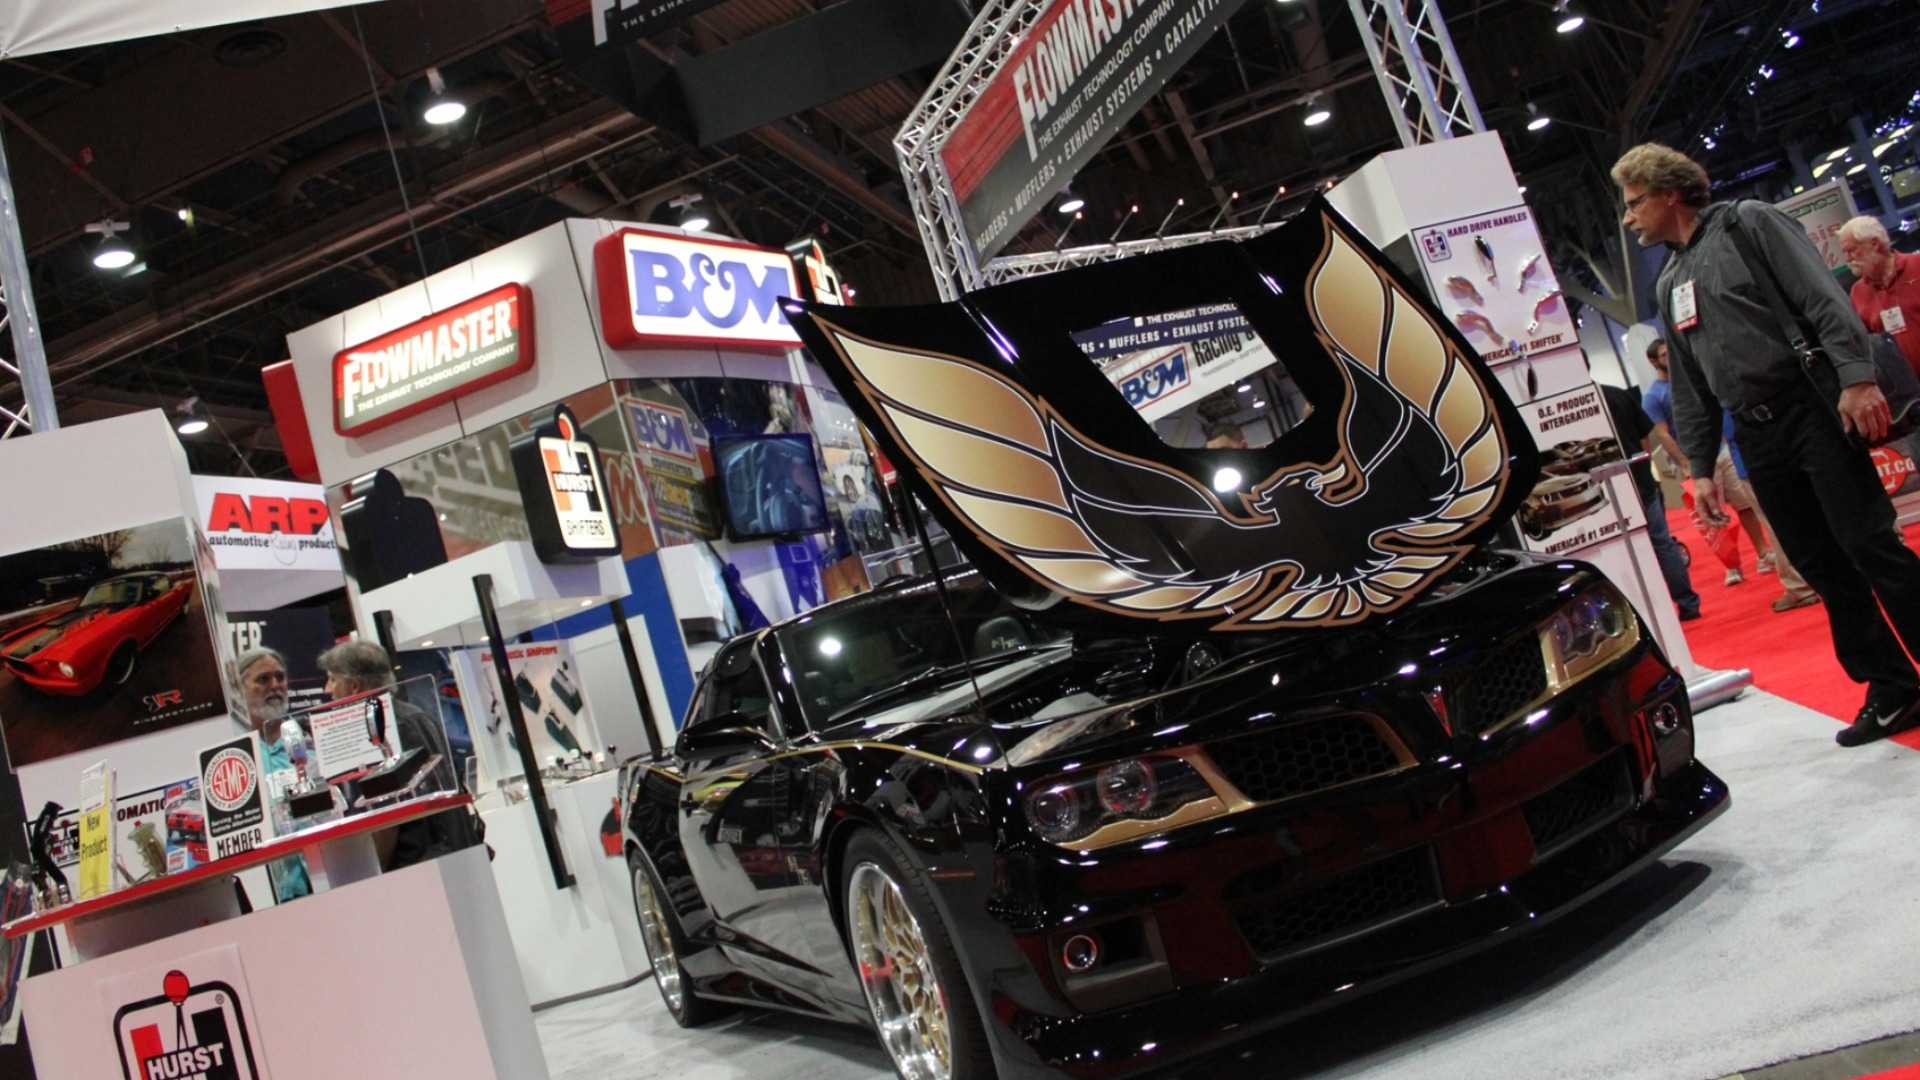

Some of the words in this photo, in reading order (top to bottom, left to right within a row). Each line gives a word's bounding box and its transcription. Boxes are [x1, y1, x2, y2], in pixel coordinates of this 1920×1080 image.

[621, 14, 646, 31] THE
[650, 0, 693, 18] EXHA
[1013, 0, 1146, 163] FLOWMAS
[1038, 129, 1055, 150] THE
[1051, 94, 1084, 134] EXHAUST
[1082, 35, 1135, 101] TECHNOLOGY
[976, 210, 1009, 254] HEADERS
[1015, 159, 1056, 212] MUFFLERS
[1063, 106, 1105, 161] EXHAUST
[1105, 55, 1153, 116] SYSTEMS
[1164, 0, 1220, 54] CATALY
[1447, 225, 1469, 238] HARD
[1469, 218, 1493, 233] DRIVE
[1493, 211, 1528, 229] HANDLES
[630, 249, 791, 329] B&M
[1108, 330, 1161, 349] MUFFLERS
[1172, 321, 1214, 338] EXHAUST
[1217, 315, 1249, 331] SYSTE
[1146, 315, 1163, 325] THE
[1162, 308, 1197, 323] EXHAUST
[1529, 333, 1562, 350] SHIFTER
[343, 300, 512, 418] FLOWMASTER
[358, 399, 375, 413] THE
[414, 360, 472, 391] TECHNOLOGY
[472, 342, 517, 367] COMPANY
[1120, 354, 1187, 406] B&M
[1537, 406, 1555, 419] O.E.
[1556, 391, 1596, 413] PRODUCT
[1539, 404, 1601, 433] INTERGRATION
[553, 472, 594, 492] HURST
[208, 493, 330, 536] ARP
[1545, 532, 1587, 555] AMERICA'S
[1588, 526, 1598, 542] #1
[213, 756, 248, 801] SEMA
[81, 838, 107, 860] Product
[216, 828, 262, 859] MEMBER
[147, 1042, 223, 1080] HURST
